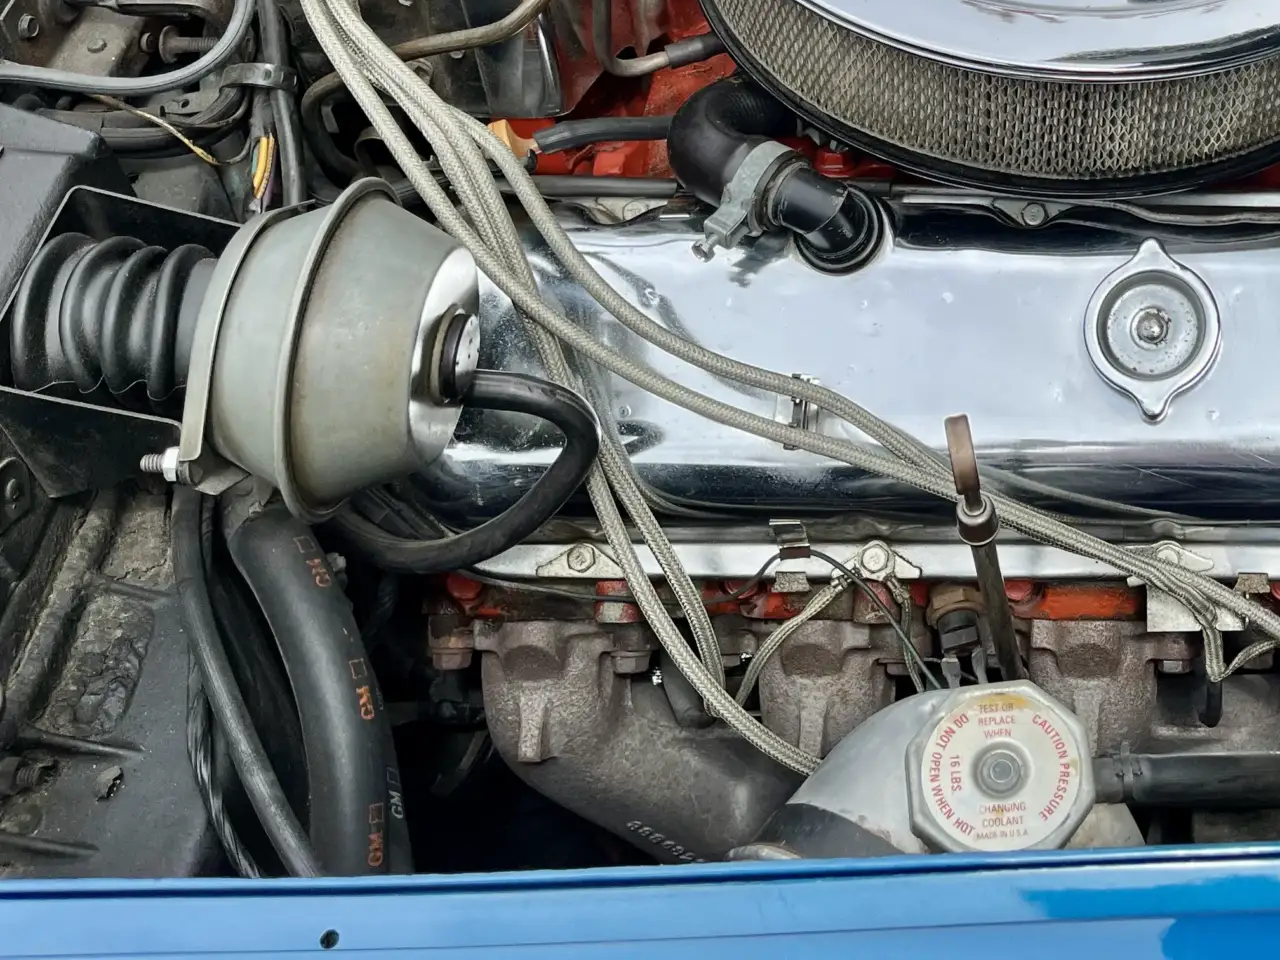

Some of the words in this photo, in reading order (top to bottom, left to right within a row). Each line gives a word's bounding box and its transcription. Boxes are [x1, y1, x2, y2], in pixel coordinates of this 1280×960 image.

[978, 704, 999, 714] TEST
[1001, 702, 1014, 712] OR
[953, 713, 970, 729] DO
[978, 716, 1017, 726] REPLACE
[936, 725, 957, 751] NOT
[983, 728, 1012, 738] WHEN
[1032, 714, 1069, 759] CAUTION
[929, 751, 943, 783] OPEN
[950, 754, 961, 768] 16
[1038, 762, 1070, 822] PRESSURE
[389, 790, 405, 819] GM
[931, 784, 955, 820] WHEN
[979, 801, 1026, 814] CHANGING
[953, 818, 976, 837] HOT
[982, 816, 1023, 828] COOLANT
